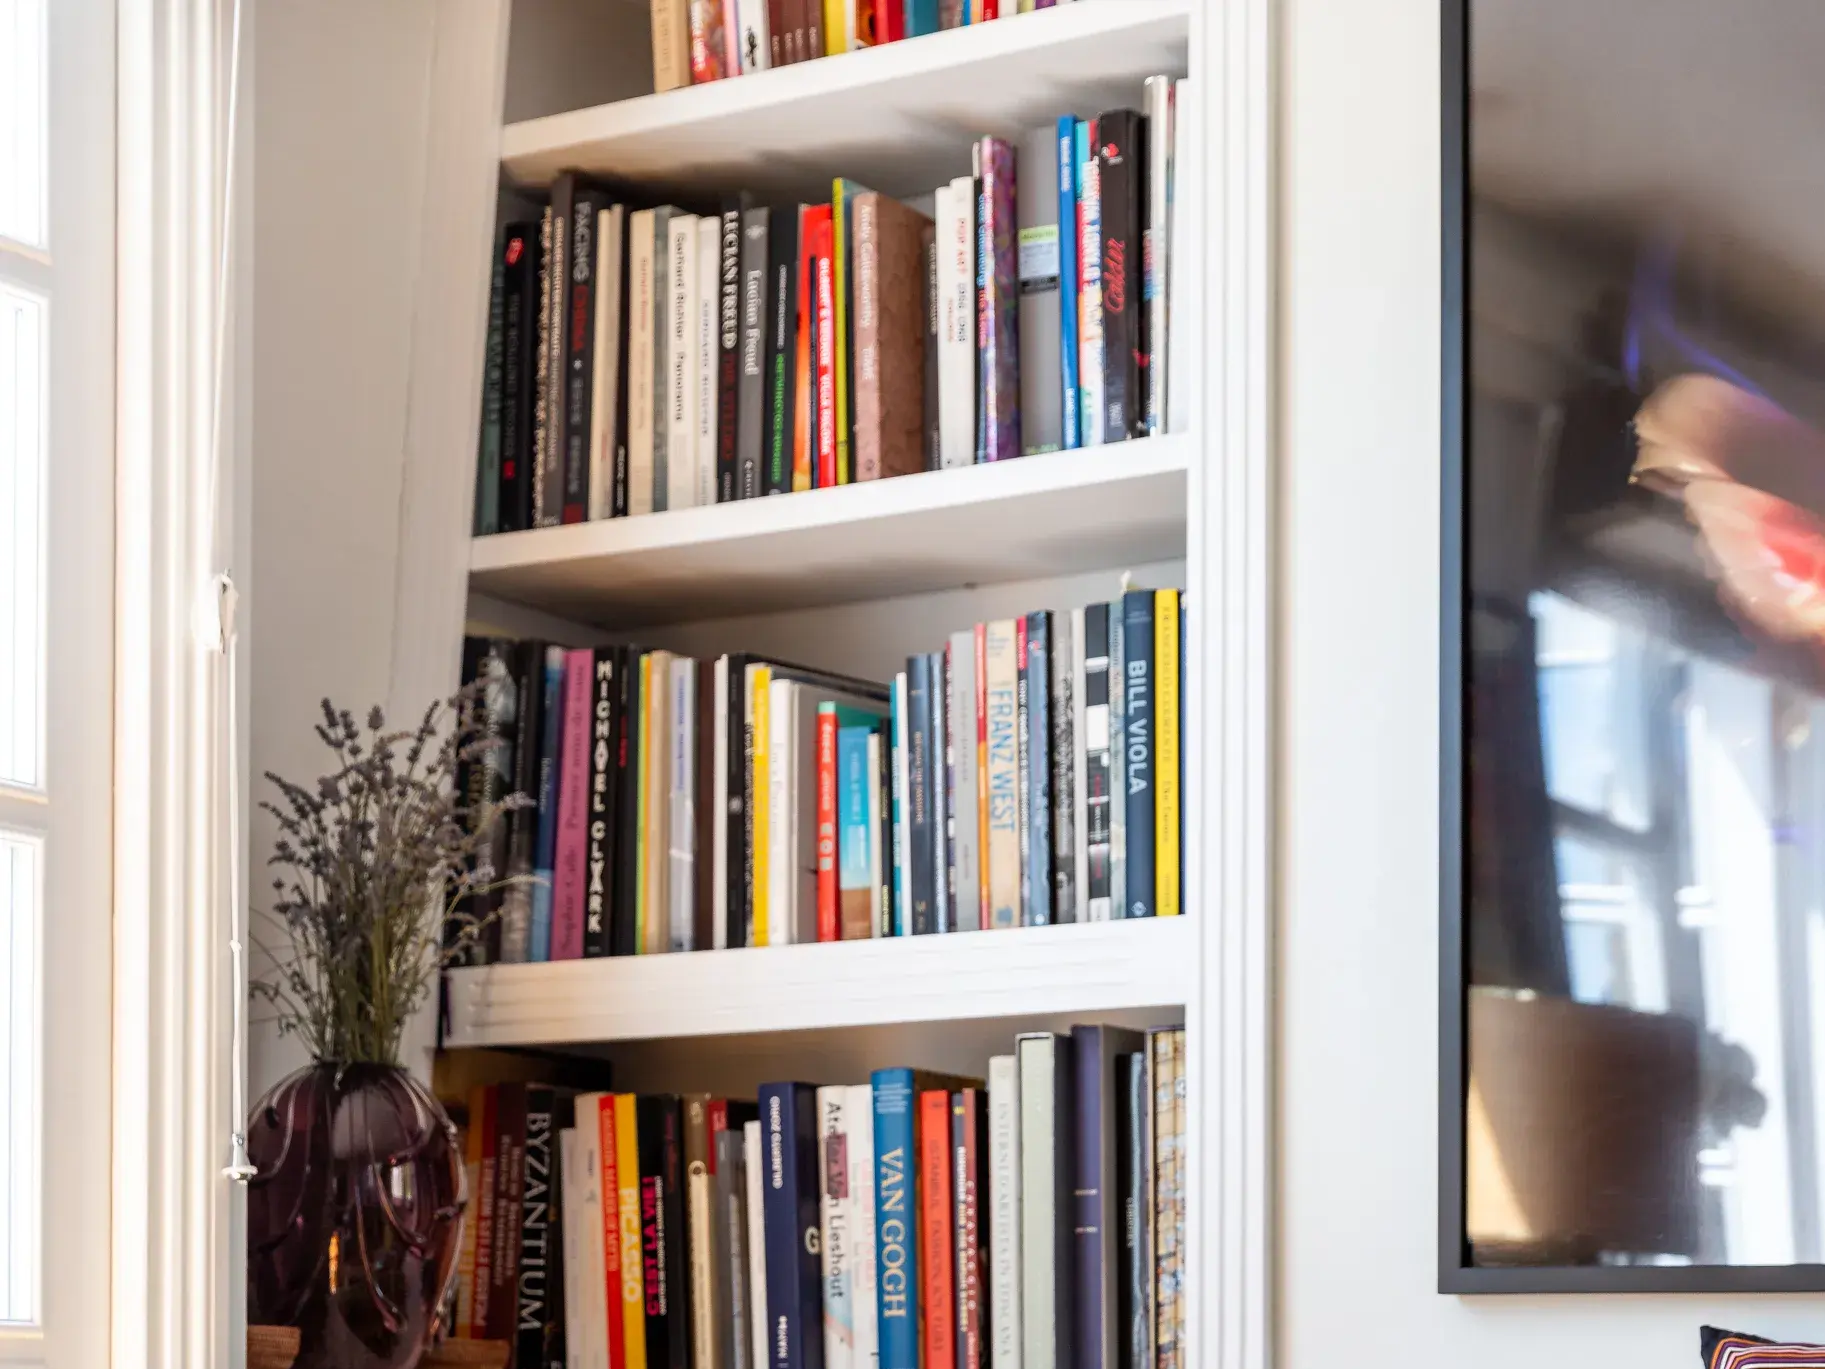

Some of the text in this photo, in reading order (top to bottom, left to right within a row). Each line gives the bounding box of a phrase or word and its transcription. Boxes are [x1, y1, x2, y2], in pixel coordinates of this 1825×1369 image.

[573, 201, 591, 282] FACING
[723, 210, 738, 283] LUCIAN
[957, 218, 967, 245] POP
[957, 249, 967, 276] ART
[721, 284, 738, 350] FREUD
[818, 258, 830, 306] GILBERT
[858, 204, 875, 381] Andy Goldsworthy TIME
[1104, 237, 1126, 316] Calder
[675, 232, 687, 422] Gerhard Richter Panorama
[745, 269, 762, 375] Lucian Freud
[818, 320, 831, 366] GEORGE
[990, 689, 1016, 833] FRANZ WEST
[1128, 659, 1148, 795] BILL VIOLA
[769, 1096, 783, 1190] GILBERTO ZORIO
[880, 1146, 905, 1212] VAN
[519, 1112, 552, 1331] BYZANTIUM
[643, 1223, 657, 1251] LA
[826, 1102, 847, 1298] Atelier Van Lieshout
[618, 1186, 642, 1303] PICASSO
[645, 1256, 659, 1316] C'EST
[881, 1218, 908, 1318] GOGH
[966, 1180, 977, 1310] CARAVAGGIO
